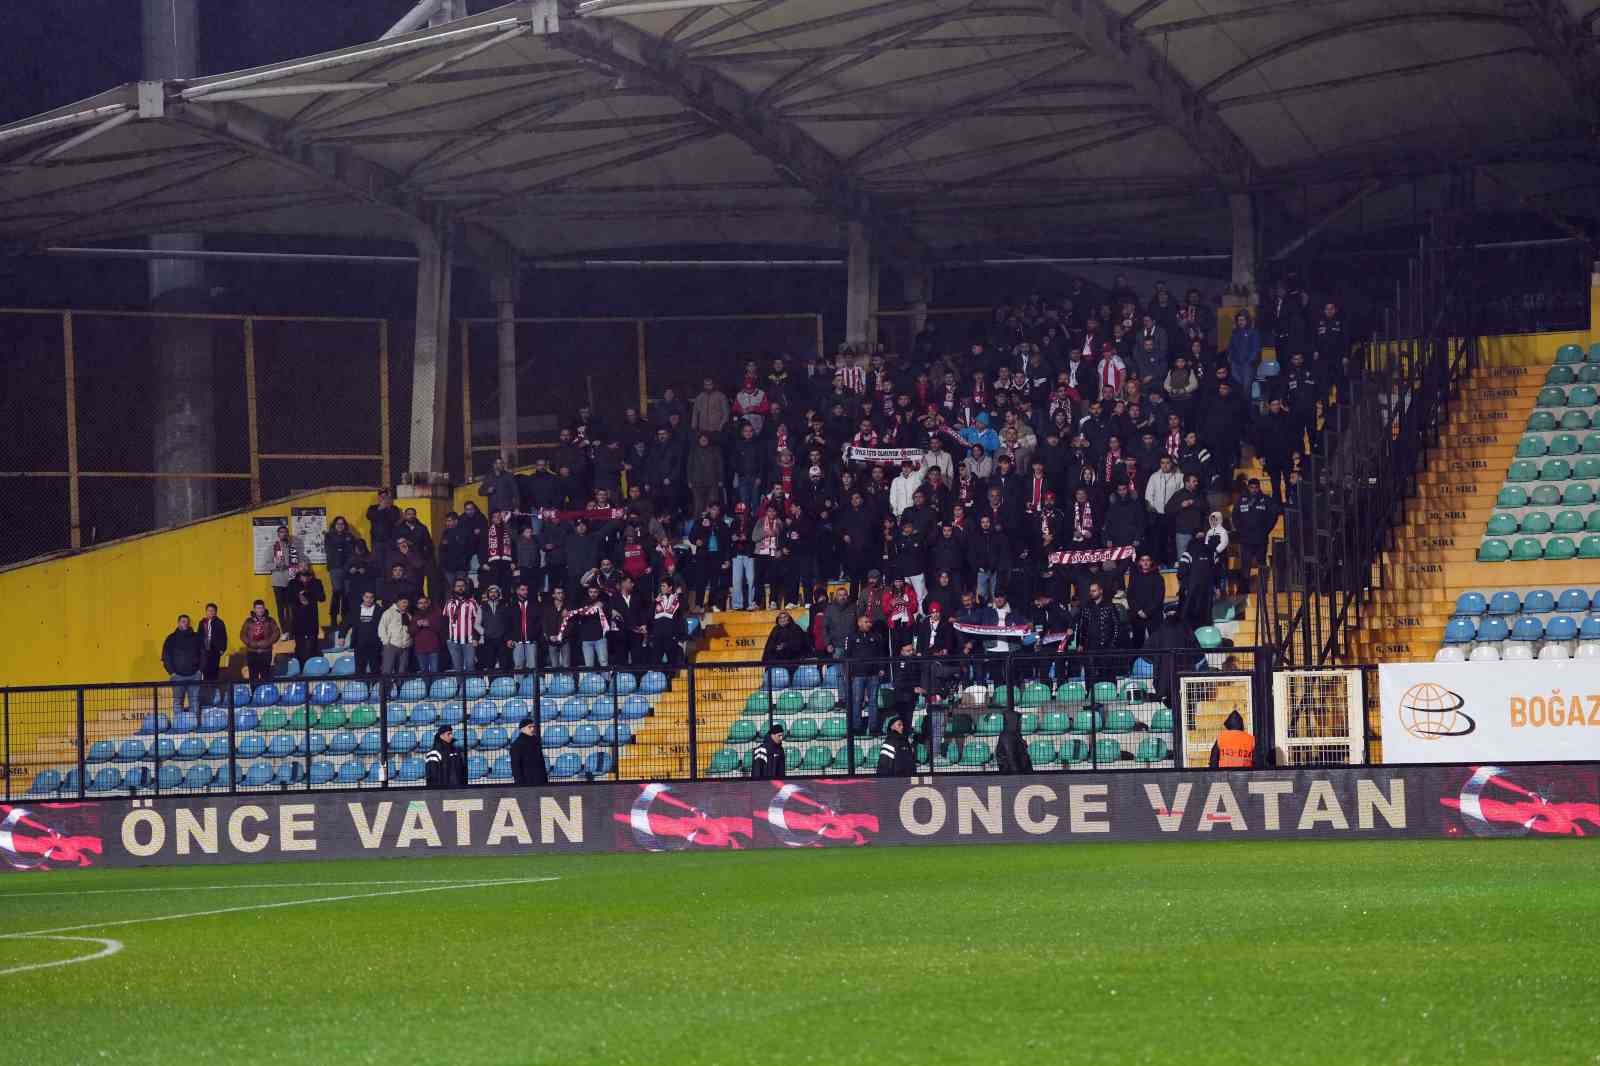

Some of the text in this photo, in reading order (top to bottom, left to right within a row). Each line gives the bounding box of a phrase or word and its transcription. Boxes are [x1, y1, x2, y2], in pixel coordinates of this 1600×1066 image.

[1509, 687, 1600, 728] BOĞAZ
[120, 795, 584, 857] ÖNCE VATAN
[898, 775, 1406, 836] ÖNCE VATAN
